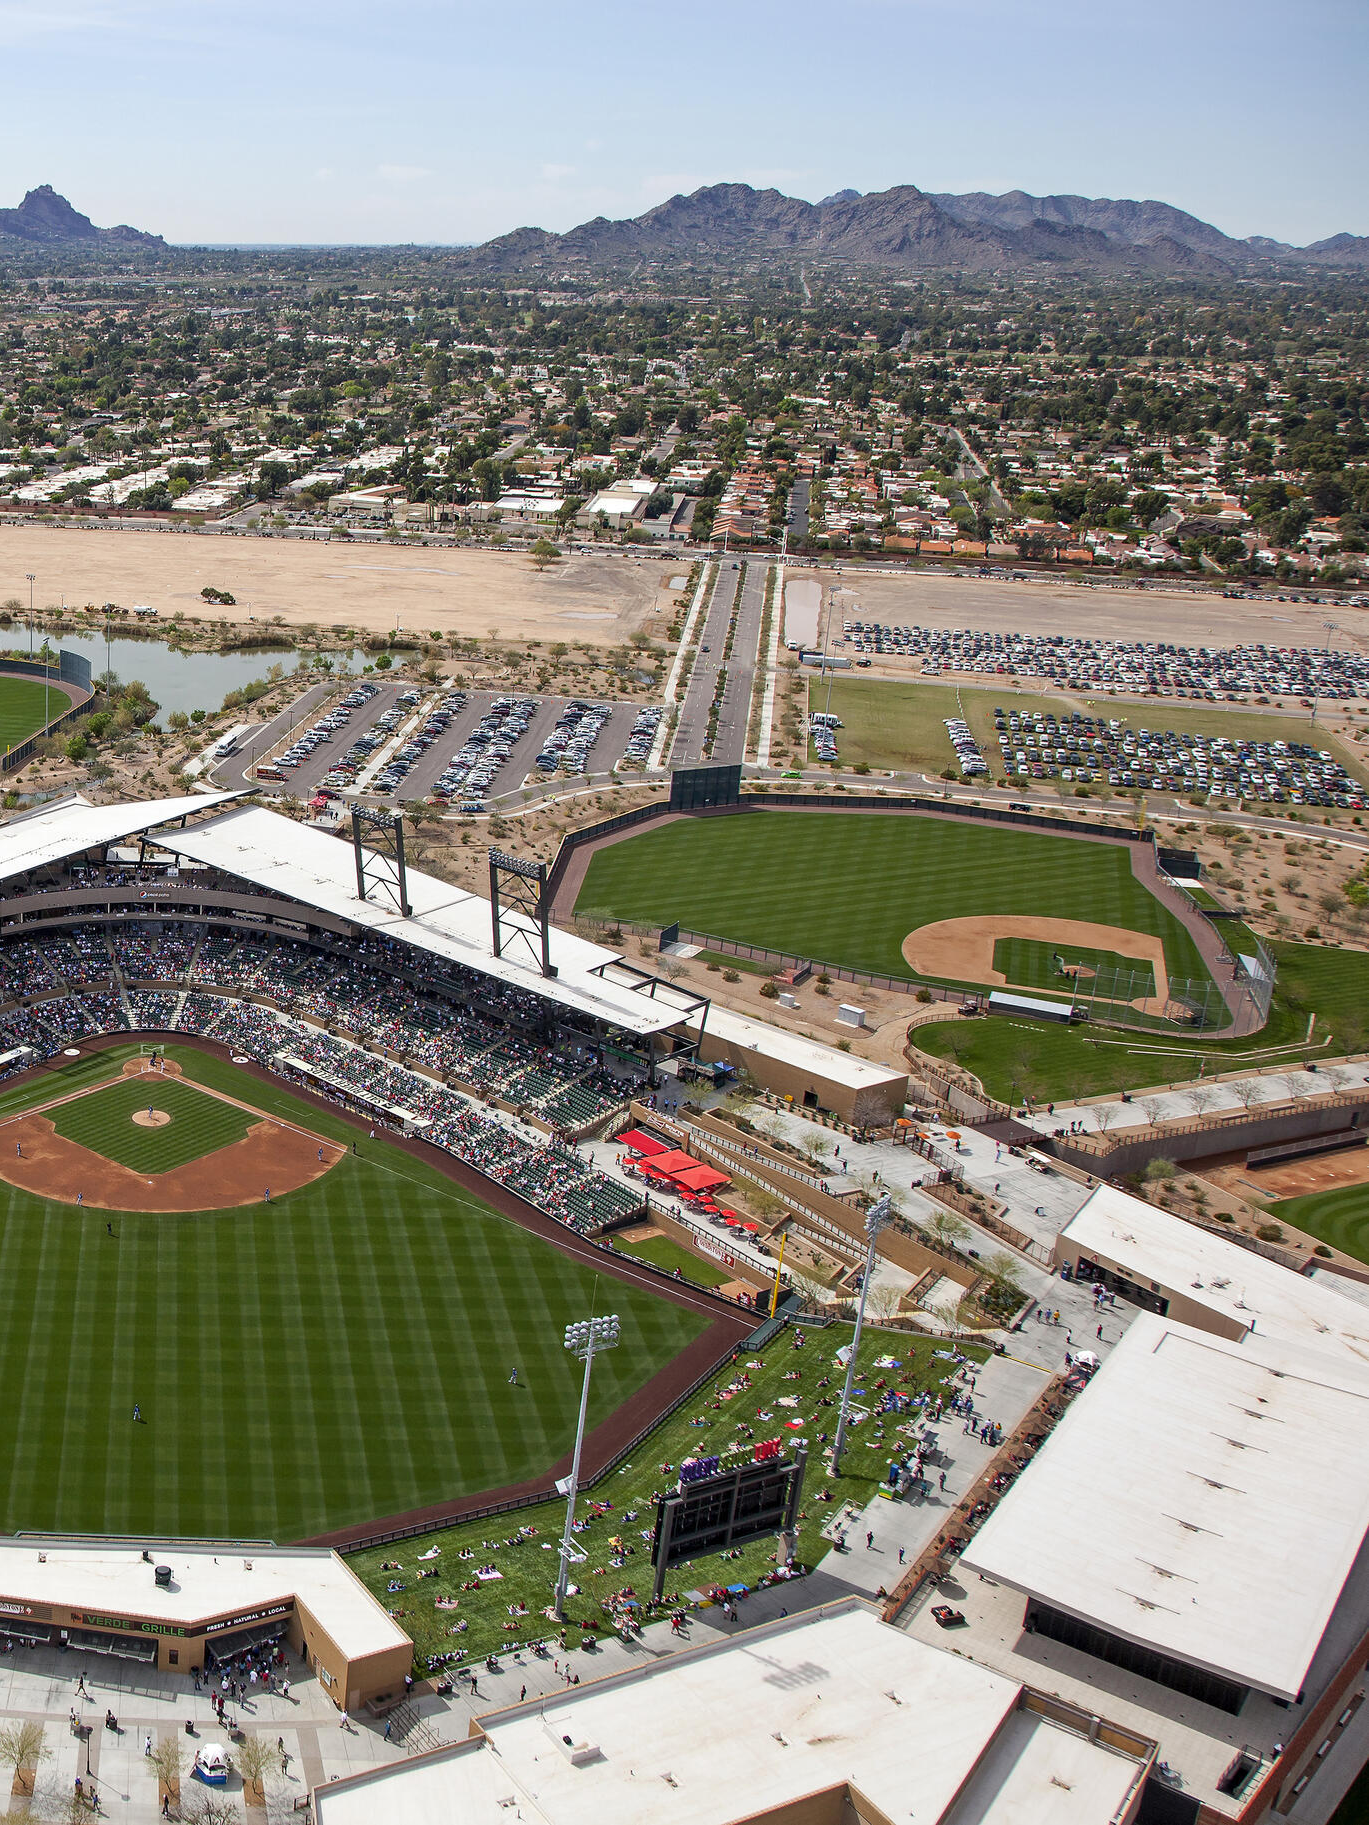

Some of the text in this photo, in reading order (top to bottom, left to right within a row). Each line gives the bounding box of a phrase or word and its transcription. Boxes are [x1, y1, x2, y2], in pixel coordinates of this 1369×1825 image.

[88, 1615, 186, 1637] VERDE GRILLE
[206, 1606, 287, 1632] FRESH NATURAL LOCAL
